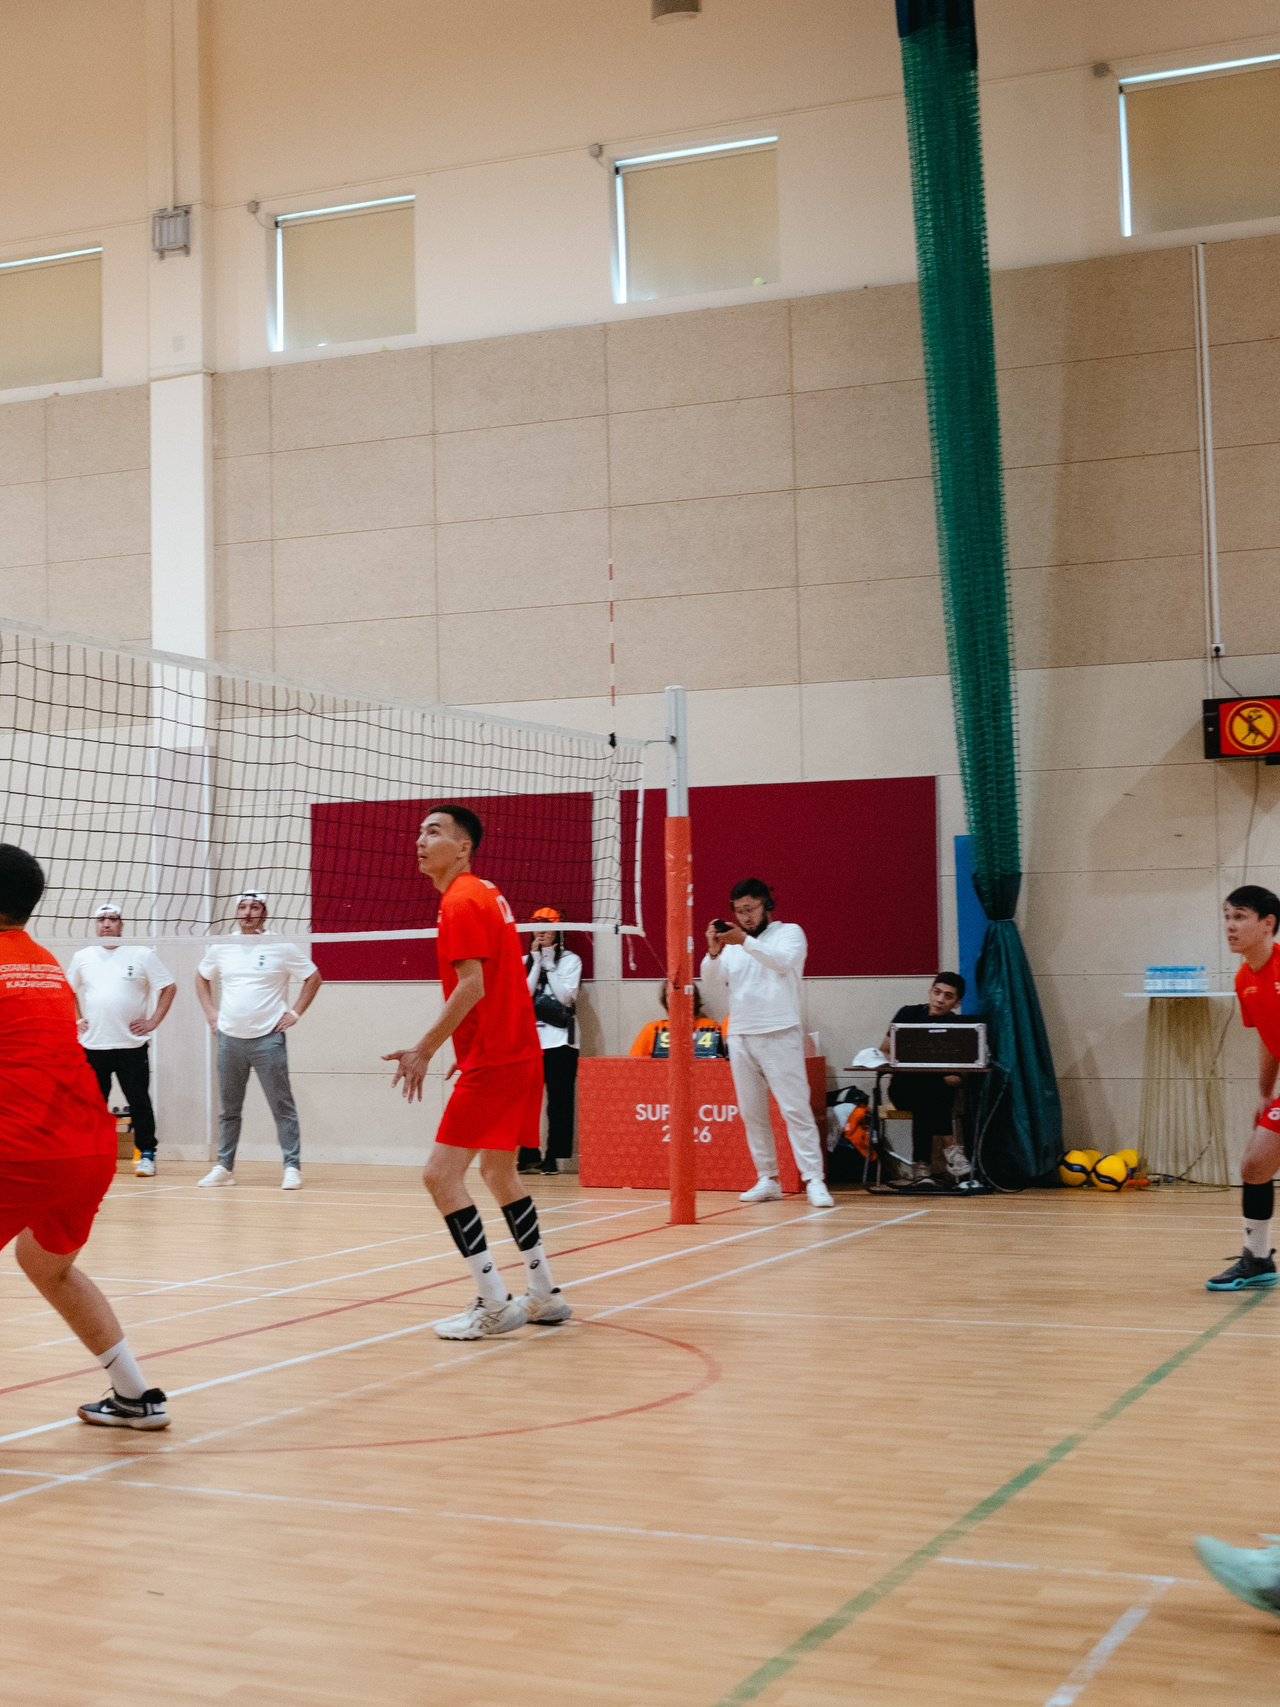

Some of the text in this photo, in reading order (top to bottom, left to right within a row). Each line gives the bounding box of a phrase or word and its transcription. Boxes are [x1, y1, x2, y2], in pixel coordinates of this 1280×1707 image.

[697, 1032, 713, 1048] 4
[635, 1103, 739, 1122] SUP CUP
[662, 1125, 712, 1143] 26
